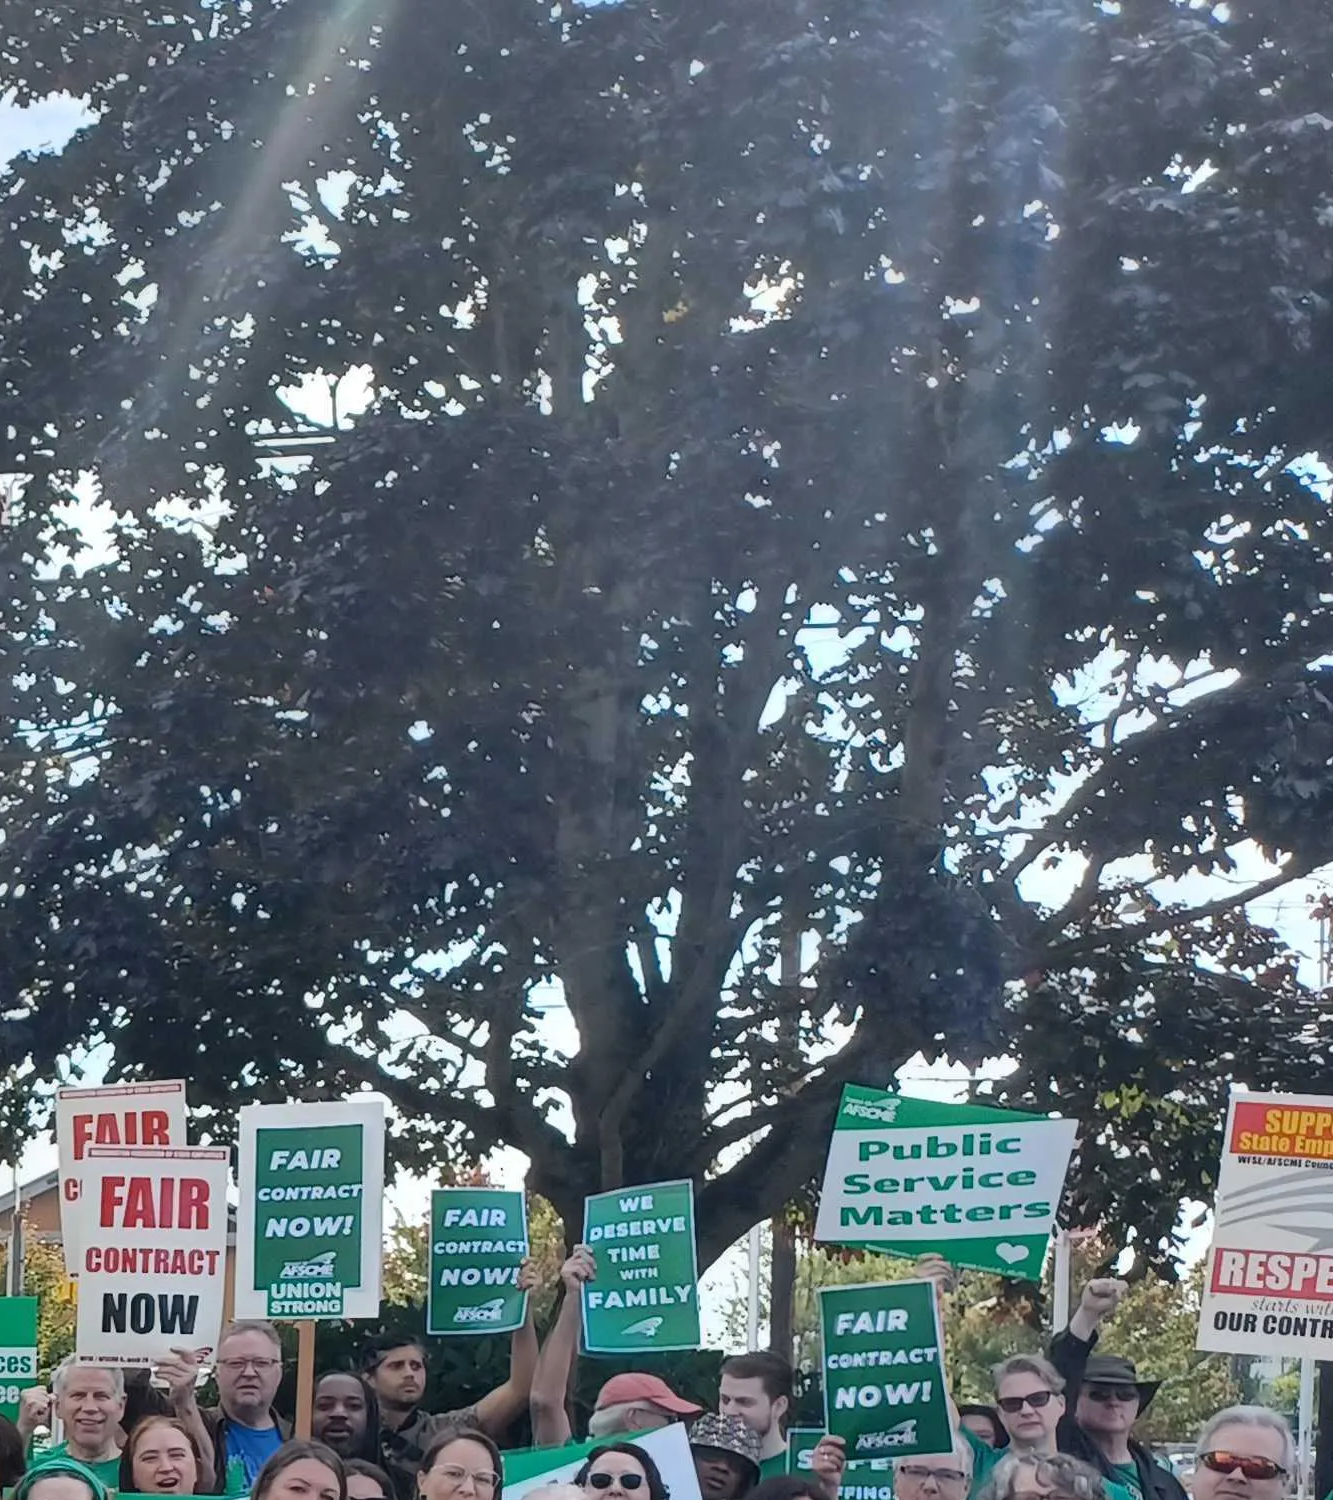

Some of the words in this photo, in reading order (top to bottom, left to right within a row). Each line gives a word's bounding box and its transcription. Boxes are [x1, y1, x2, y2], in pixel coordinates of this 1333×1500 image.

[72, 1110, 171, 1160] FAIR
[1264, 1108, 1333, 1137] SUPP
[858, 1132, 1022, 1163] Public
[1239, 1132, 1290, 1150] State
[270, 1148, 342, 1171] FAIR
[257, 1183, 363, 1202] CONTRACT
[842, 1168, 1038, 1195] Service
[99, 1176, 211, 1230] FAIR
[619, 1195, 653, 1213] WE
[839, 1199, 1052, 1228] Matters
[265, 1214, 355, 1239] NOW!
[444, 1208, 508, 1228] FAIR
[589, 1216, 687, 1242] DESERVE
[434, 1239, 529, 1256] CONTRACT
[607, 1244, 661, 1263] TIME
[85, 1247, 221, 1276] CONTRACT
[279, 1261, 335, 1279] AFSCME
[620, 1267, 659, 1281] WITH
[1218, 1251, 1333, 1294] RESPE
[439, 1266, 520, 1287] NOW!
[271, 1282, 342, 1299] UNION
[587, 1283, 694, 1310] FAMILY
[101, 1292, 200, 1335] NOW
[270, 1299, 342, 1315] STRONG
[1251, 1298, 1301, 1315] starts
[835, 1307, 909, 1336] FAIR
[1214, 1311, 1258, 1333] OUR
[1262, 1316, 1333, 1339] CONTR
[827, 1345, 938, 1370] CONTRACT
[834, 1380, 932, 1410] NOW!
